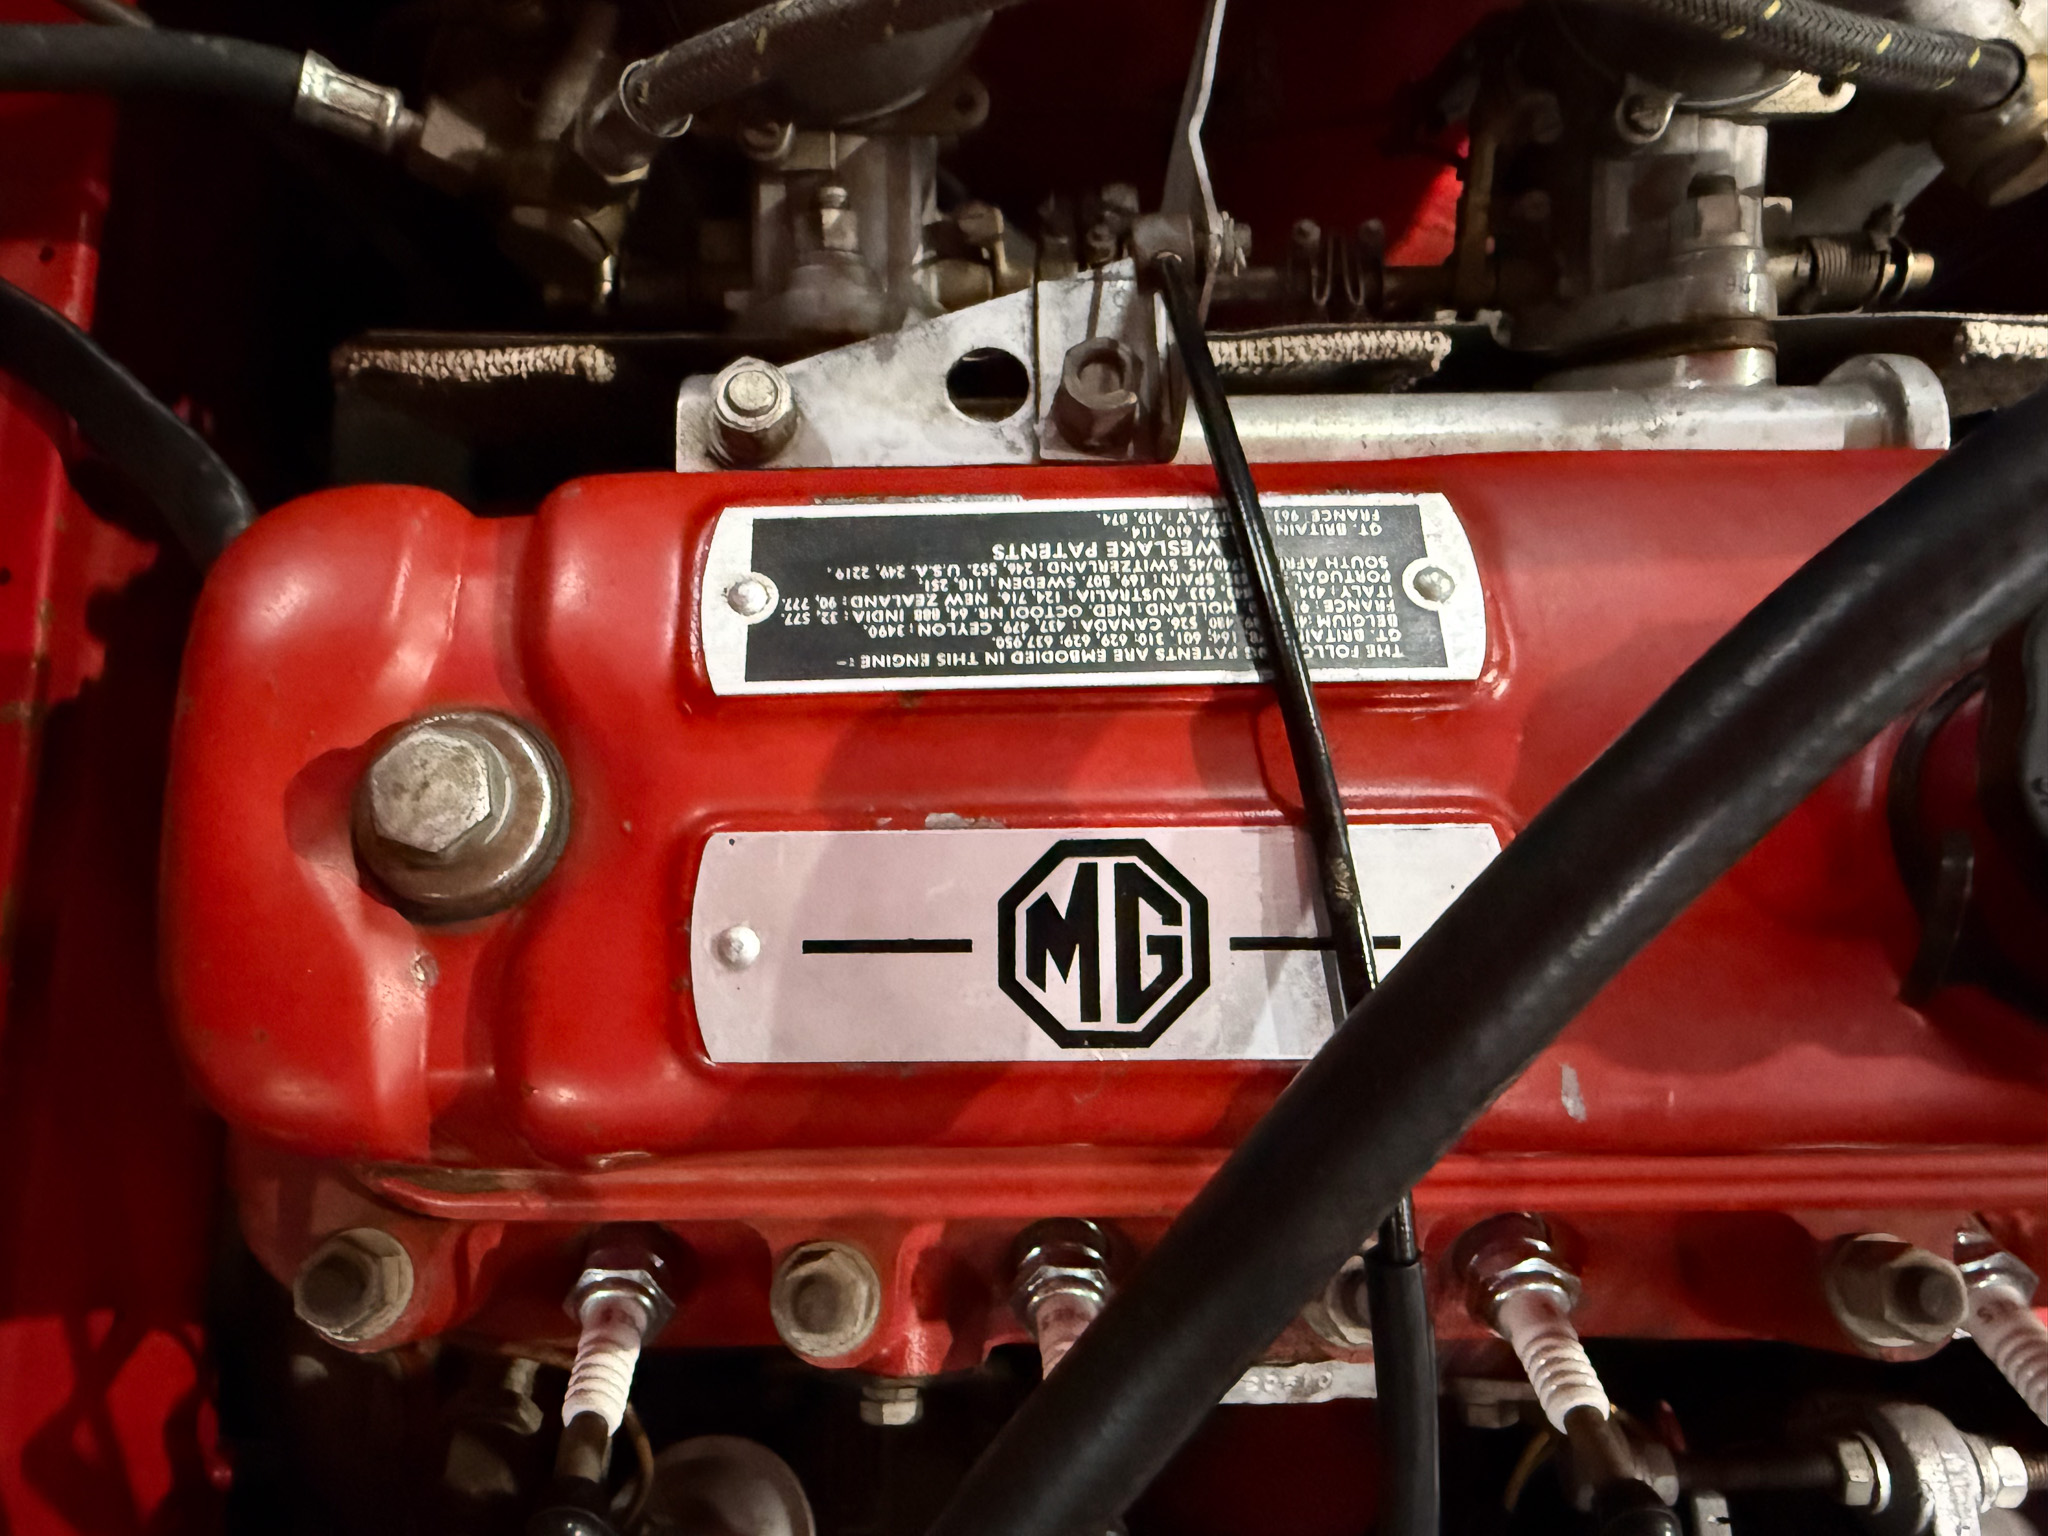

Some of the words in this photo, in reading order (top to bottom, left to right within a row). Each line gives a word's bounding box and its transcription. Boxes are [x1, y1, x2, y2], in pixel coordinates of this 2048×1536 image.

[992, 541, 1097, 560] PATENTS
[1106, 540, 1222, 558] WESLAKE
[1326, 556, 1388, 569] SOUTH
[945, 592, 988, 606] NEW
[975, 607, 1003, 620] NR.
[1011, 604, 1082, 619] OCTOOI
[1089, 603, 1130, 617] NED.
[1011, 648, 1106, 664] EMBODIED
[1114, 648, 1148, 662] ARE
[1155, 646, 1238, 661] PATENTS
[1245, 644, 1359, 660] FOLLOG
[1366, 644, 1404, 658] THE
[861, 653, 930, 669] ENGINE
[936, 652, 978, 666] THIS
[984, 652, 1004, 665] IN
[1024, 860, 1184, 1024] MG
